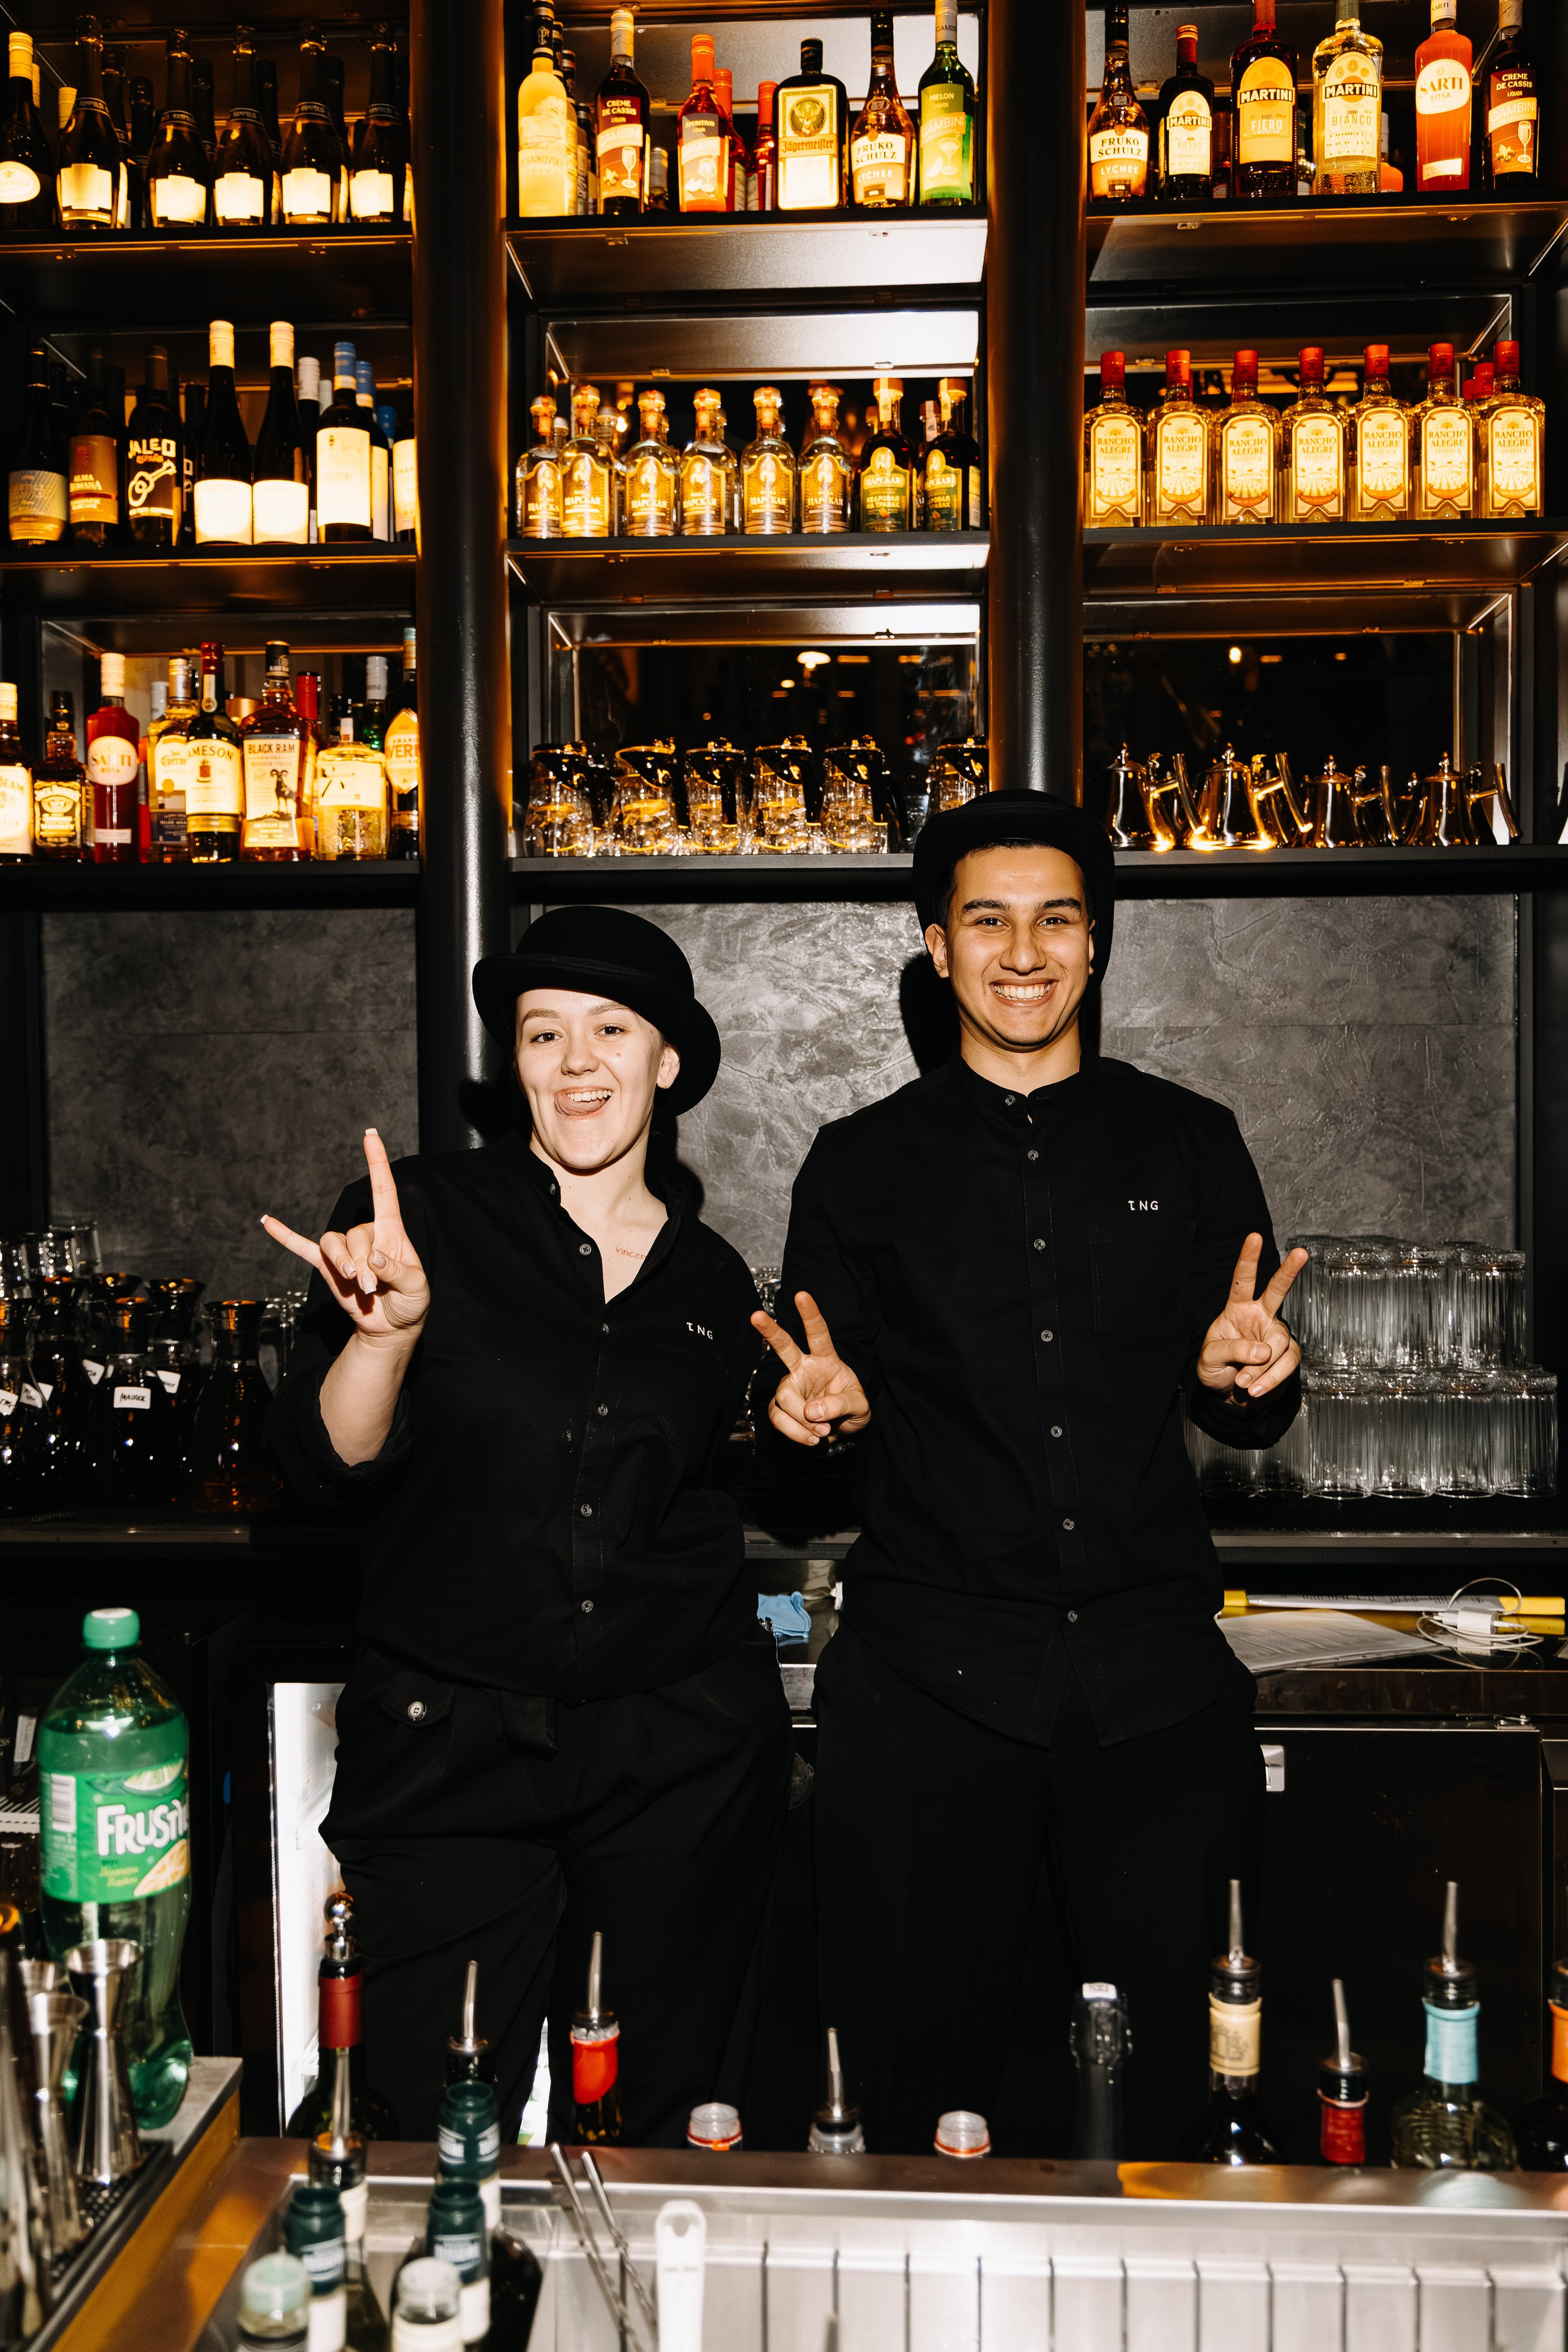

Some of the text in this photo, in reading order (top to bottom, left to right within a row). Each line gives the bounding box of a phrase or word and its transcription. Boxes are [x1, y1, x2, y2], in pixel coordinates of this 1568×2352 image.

[1502, 73, 1528, 81] CREME
[1420, 77, 1463, 97] SARTI
[1507, 80, 1532, 89] CASSIS
[1240, 88, 1292, 104] MARTINI
[1326, 83, 1377, 98] MARTINI
[929, 92, 954, 102] MELON
[1430, 92, 1451, 101] ROSA
[606, 99, 631, 108] CREME
[611, 107, 637, 116] CASSIS
[1491, 100, 1536, 123] GAMBINI
[1169, 115, 1210, 127] MARTINI
[1251, 119, 1283, 132] FIERO
[1332, 115, 1371, 126] BIANCO
[922, 115, 964, 138] GAMBINI
[858, 141, 893, 155] FRUKO
[1101, 137, 1139, 148] FRUKO
[1098, 146, 1142, 158] SCHULZ
[855, 151, 897, 166] SCHULZ
[858, 168, 894, 183] LYCHEE
[1101, 164, 1139, 176] LYCHEE
[1364, 431, 1402, 440] RANCHO
[1428, 430, 1466, 439] RANCHO
[1495, 430, 1532, 439] RANCHO
[1098, 437, 1134, 446] RANCHO
[1229, 439, 1267, 447] RANCHO
[1298, 437, 1336, 446] RANCHO
[1366, 440, 1400, 448] ALEGRE
[1431, 438, 1465, 447] ALEGRE
[1497, 438, 1531, 447] ALEGRE
[127, 437, 176, 459] JALEO
[1166, 443, 1200, 452] ALEGRE
[1301, 445, 1335, 454] ALEGRE
[865, 475, 901, 486] ЦАРСКАЯ
[925, 476, 952, 488] АРСКАЯ
[565, 495, 600, 506] ЦАРСКАЯ
[631, 499, 668, 509] ЦАРСКАЯ
[683, 497, 717, 509] ЦАРСКАЯ
[528, 503, 560, 513] ЦАРСКА
[187, 745, 234, 761] AMESON
[247, 744, 295, 754] BLACK RAM
[92, 754, 131, 767] SATI
[1128, 1200, 1158, 1211] TNG
[686, 1321, 714, 1341] TNG
